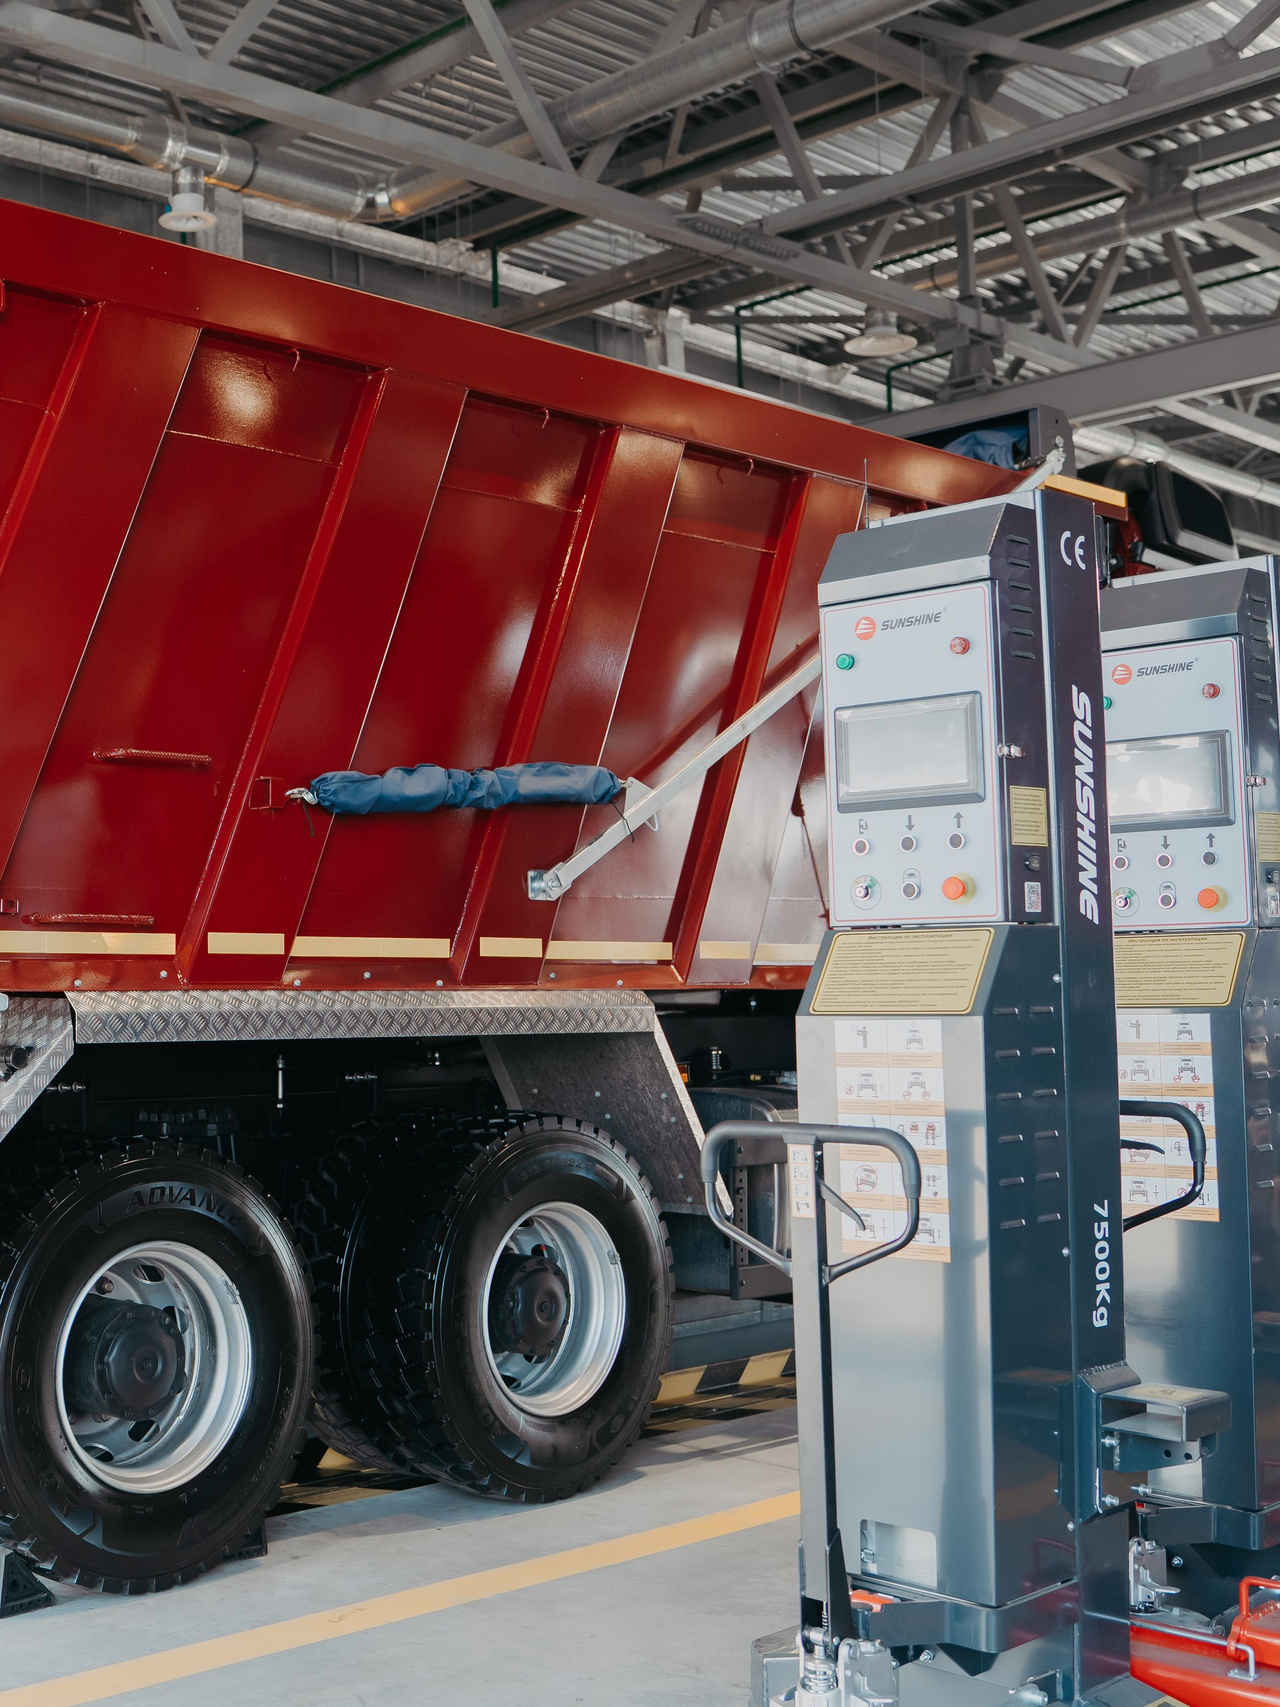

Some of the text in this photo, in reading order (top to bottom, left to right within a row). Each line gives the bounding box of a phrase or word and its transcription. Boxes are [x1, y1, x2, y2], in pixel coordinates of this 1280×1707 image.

[1060, 530, 1086, 571] CE
[880, 611, 942, 631] SUNSHINE
[1136, 661, 1194, 677] SUNSHINE
[1071, 684, 1100, 926] SUNSHINE
[125, 1185, 241, 1228] ADVANCE
[1092, 1199, 1111, 1328] 7500Kg
